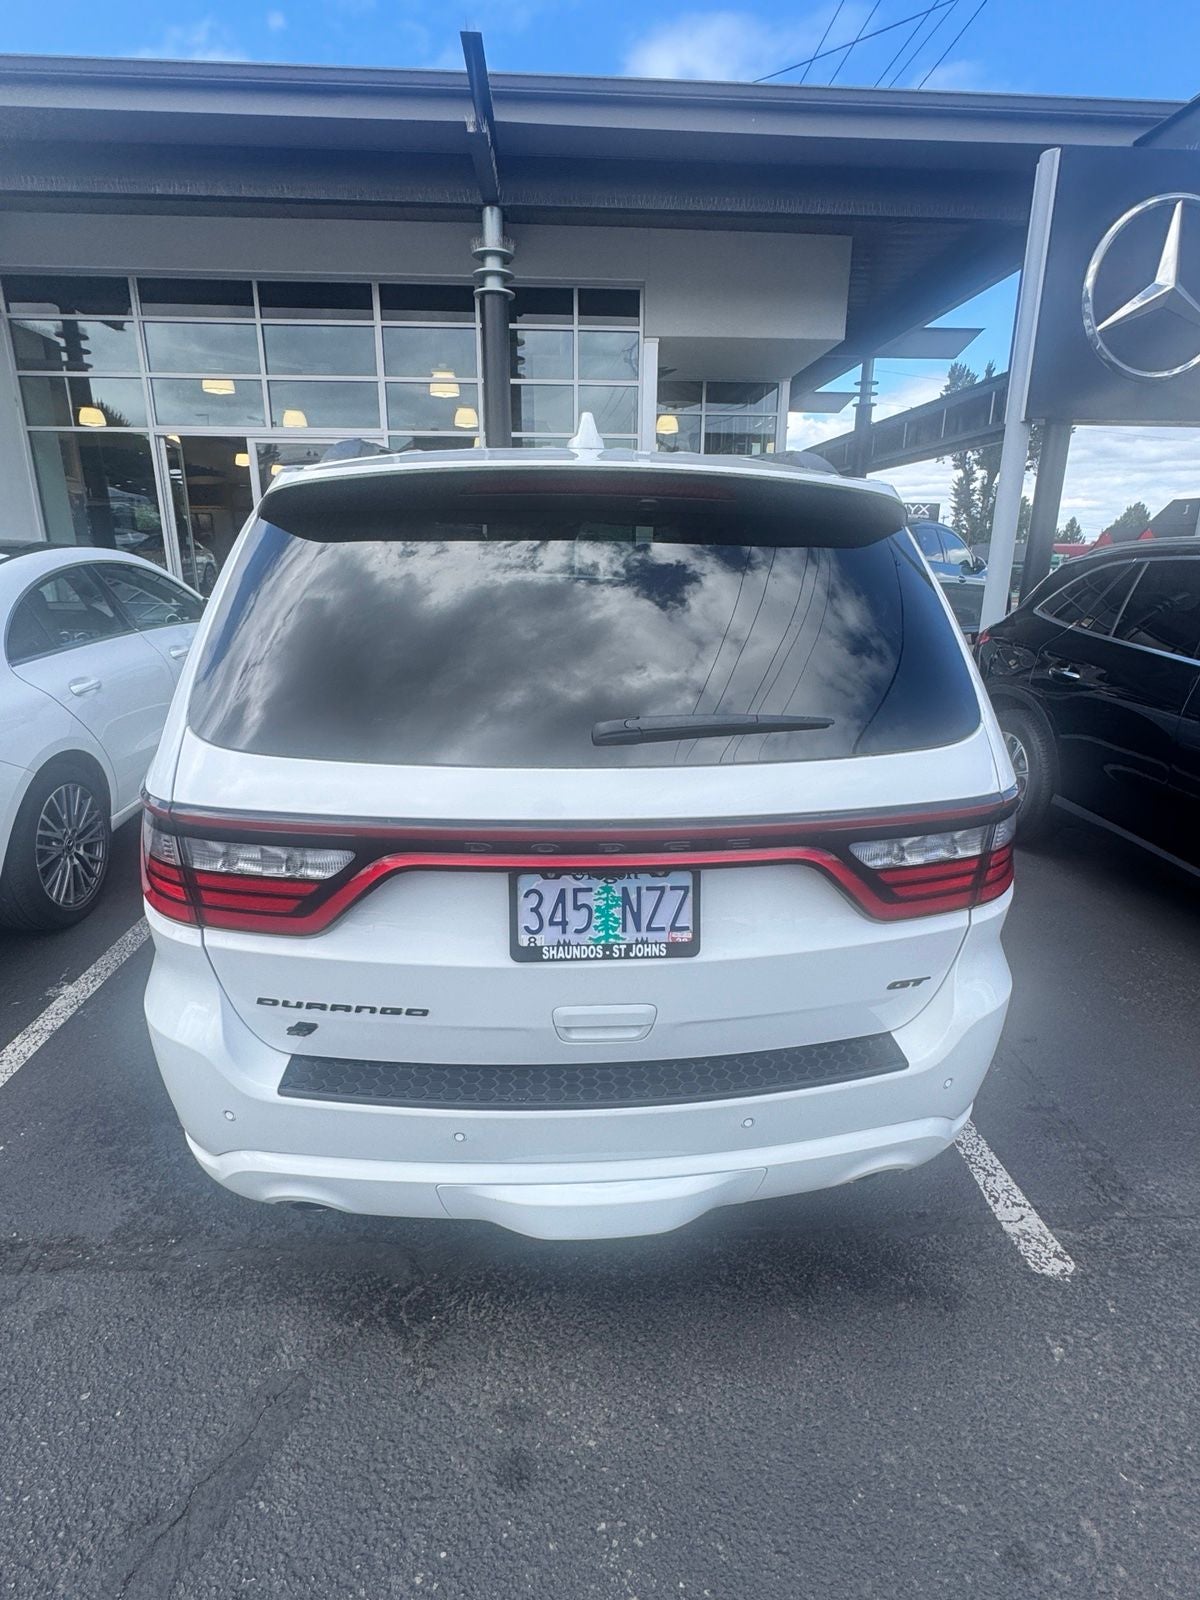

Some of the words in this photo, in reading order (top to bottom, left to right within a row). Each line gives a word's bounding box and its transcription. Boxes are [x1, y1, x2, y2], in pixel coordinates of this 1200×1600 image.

[464, 839, 751, 852] DODGE
[523, 888, 593, 935] 345
[622, 885, 690, 933] NZZ
[542, 945, 602, 959] SHAUNDOS
[612, 946, 627, 957] ST
[629, 944, 667, 957] JOHNS
[886, 976, 931, 990] GT
[256, 997, 429, 1017] DURANGO
